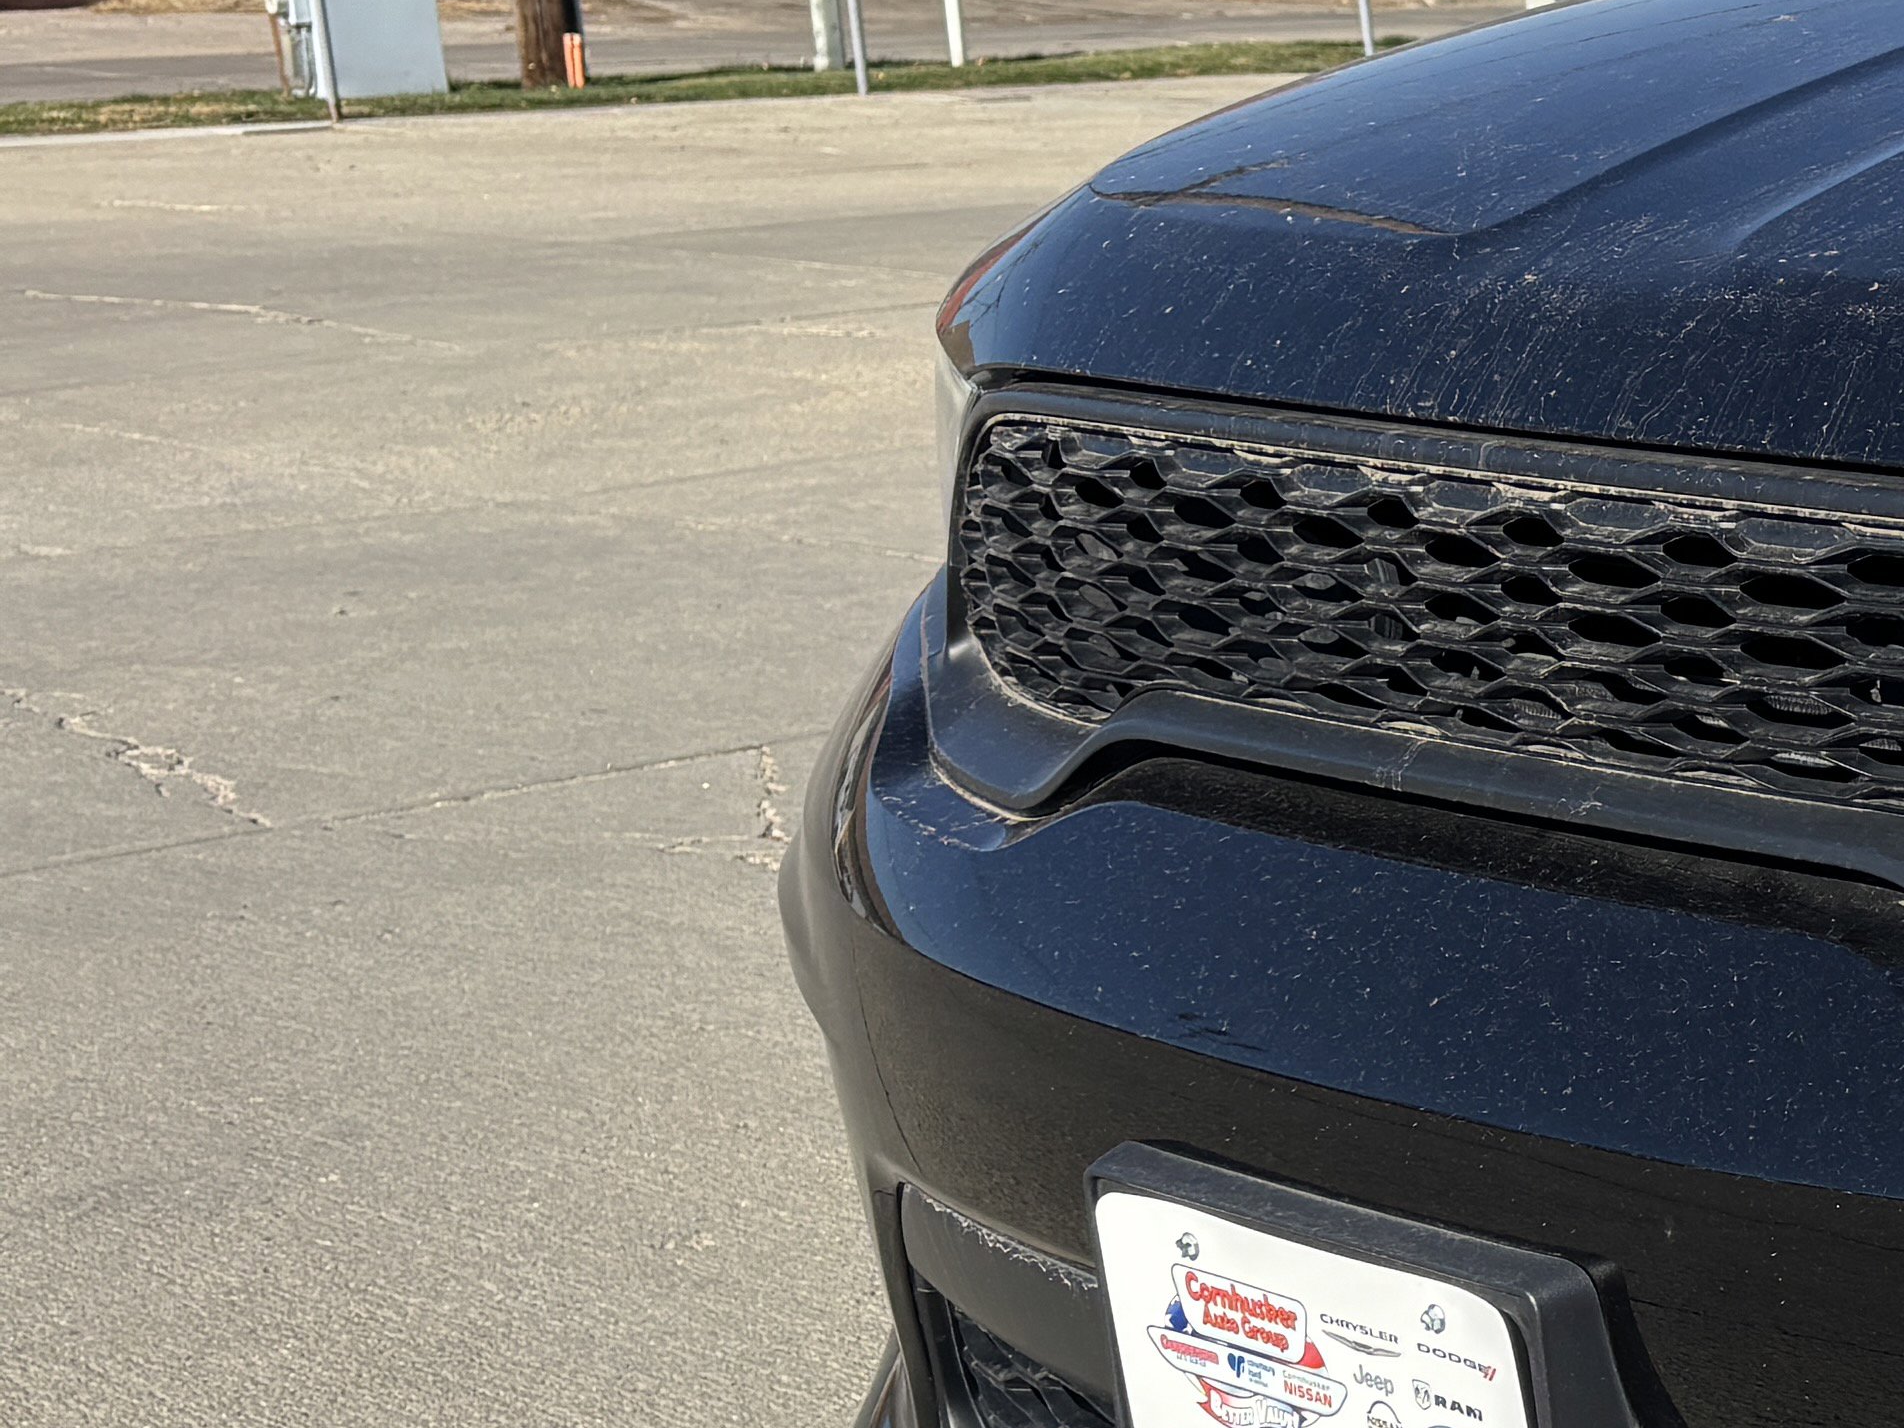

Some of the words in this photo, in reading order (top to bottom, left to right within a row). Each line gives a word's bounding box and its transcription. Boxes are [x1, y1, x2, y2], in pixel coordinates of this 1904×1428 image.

[1320, 1313, 1398, 1345] CHRYSLER
[1417, 1342, 1490, 1376] DODGE
[1284, 1380, 1333, 1408] NISSAN
[1353, 1364, 1395, 1397] Jeep
[1434, 1394, 1483, 1422] RAM
